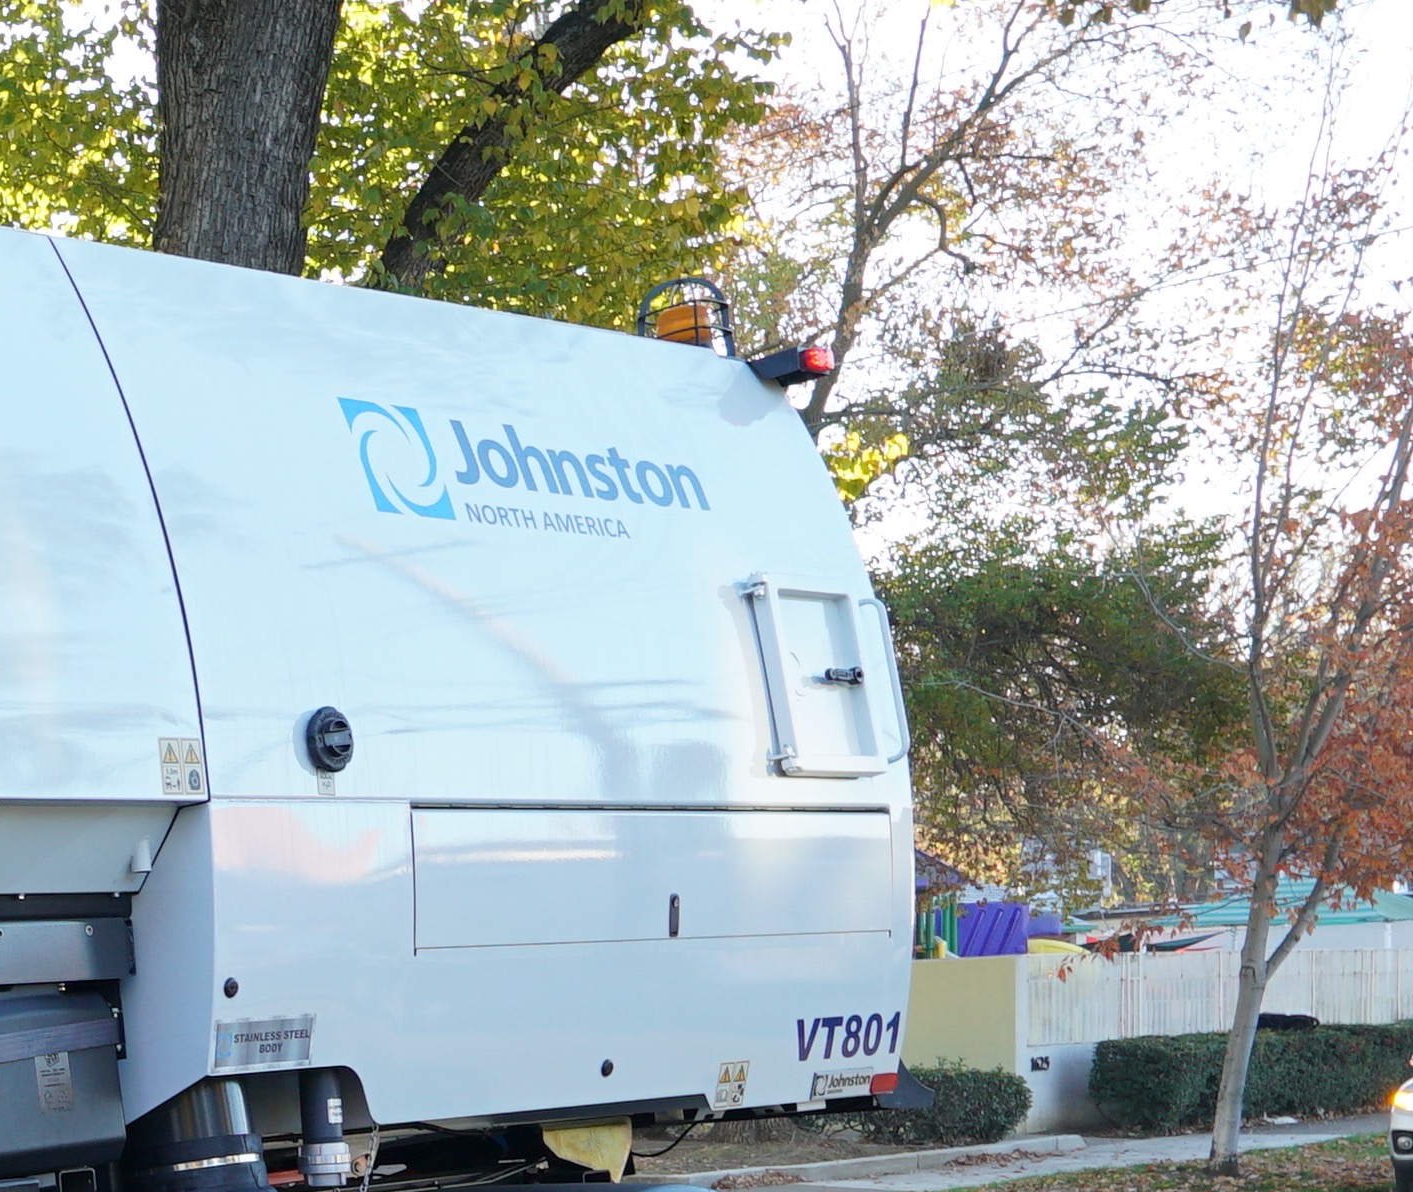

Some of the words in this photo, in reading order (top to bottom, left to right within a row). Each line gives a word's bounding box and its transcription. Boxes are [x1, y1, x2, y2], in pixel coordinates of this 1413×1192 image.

[449, 419, 711, 511] Johnston
[465, 502, 538, 531] NORTH
[543, 511, 631, 540] AMERICA
[233, 1030, 281, 1044] STAINLESS
[283, 1028, 311, 1040] STEEL
[259, 1043, 283, 1054] BODY
[796, 1011, 901, 1062] VT801
[828, 1072, 871, 1089] Johnston
